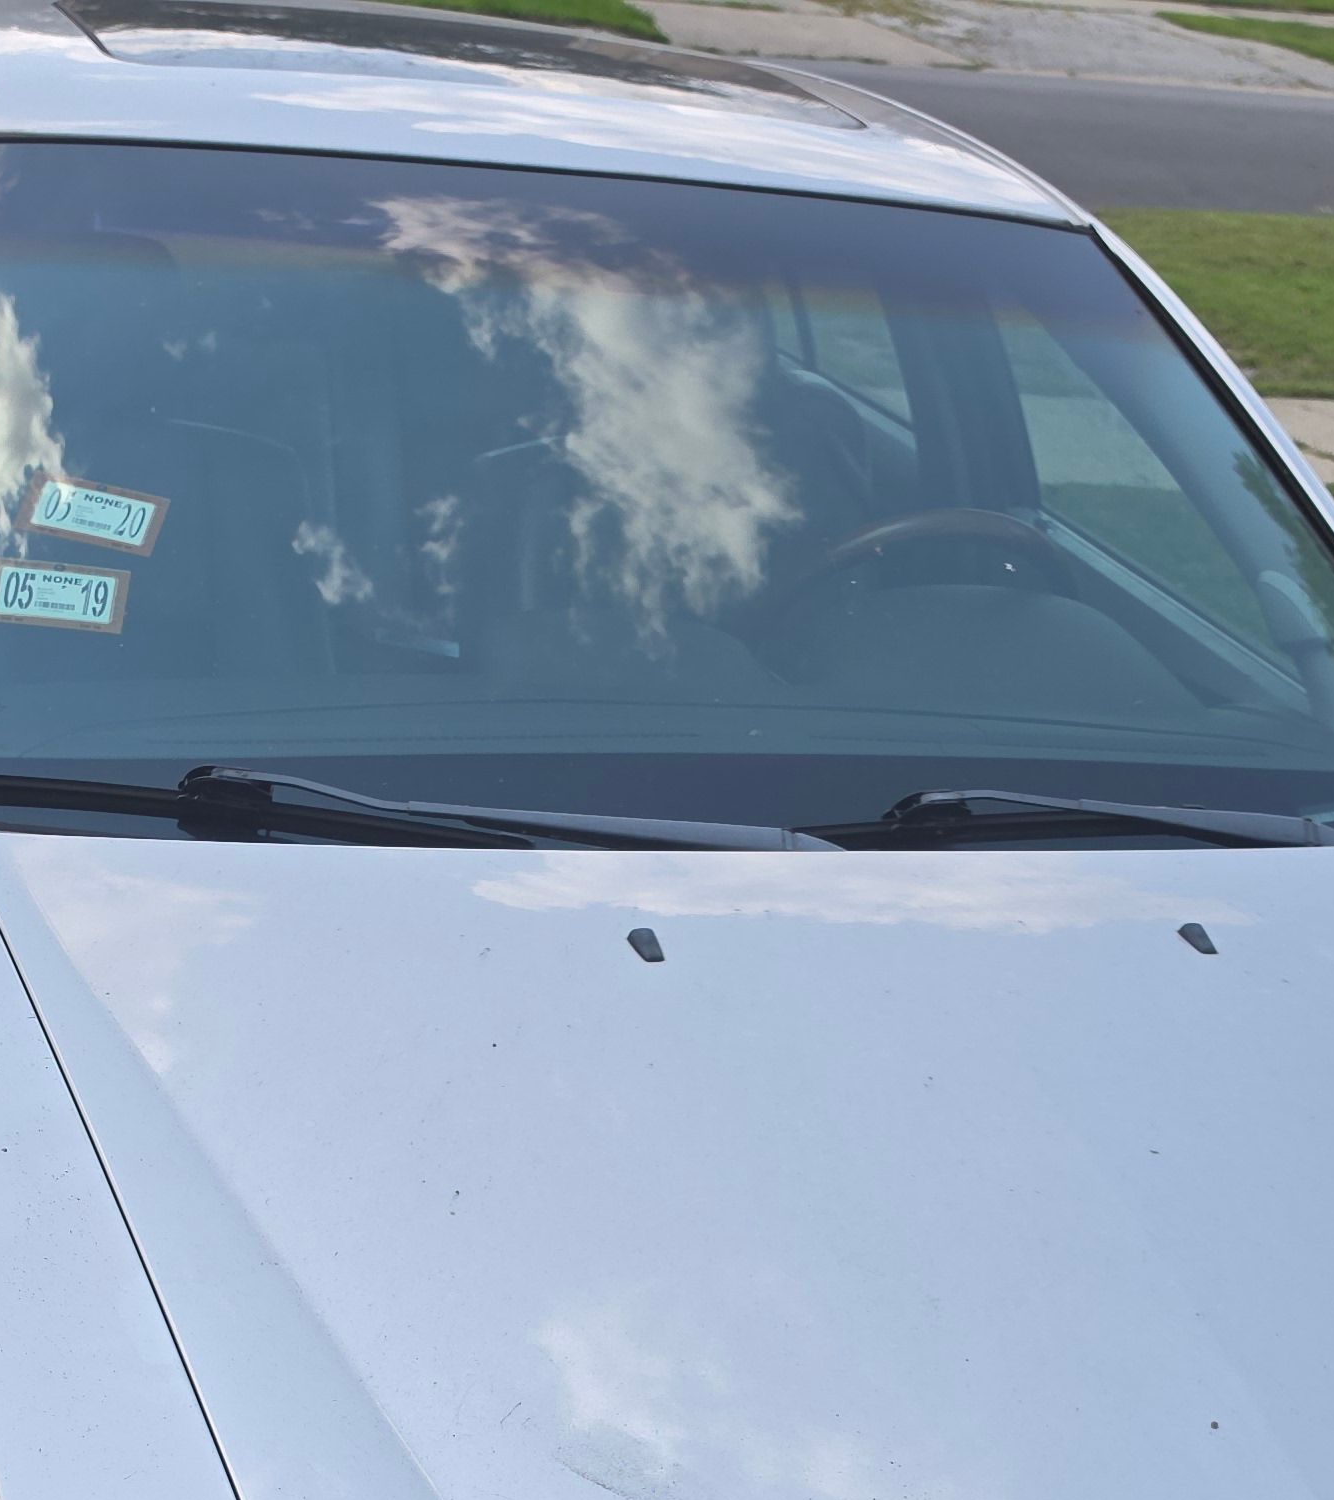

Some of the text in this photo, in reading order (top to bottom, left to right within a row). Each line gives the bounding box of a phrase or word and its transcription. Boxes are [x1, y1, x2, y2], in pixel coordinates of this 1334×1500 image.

[84, 493, 124, 509] NONE
[113, 503, 146, 538] 20
[3, 571, 109, 617] 05 NONE 19
